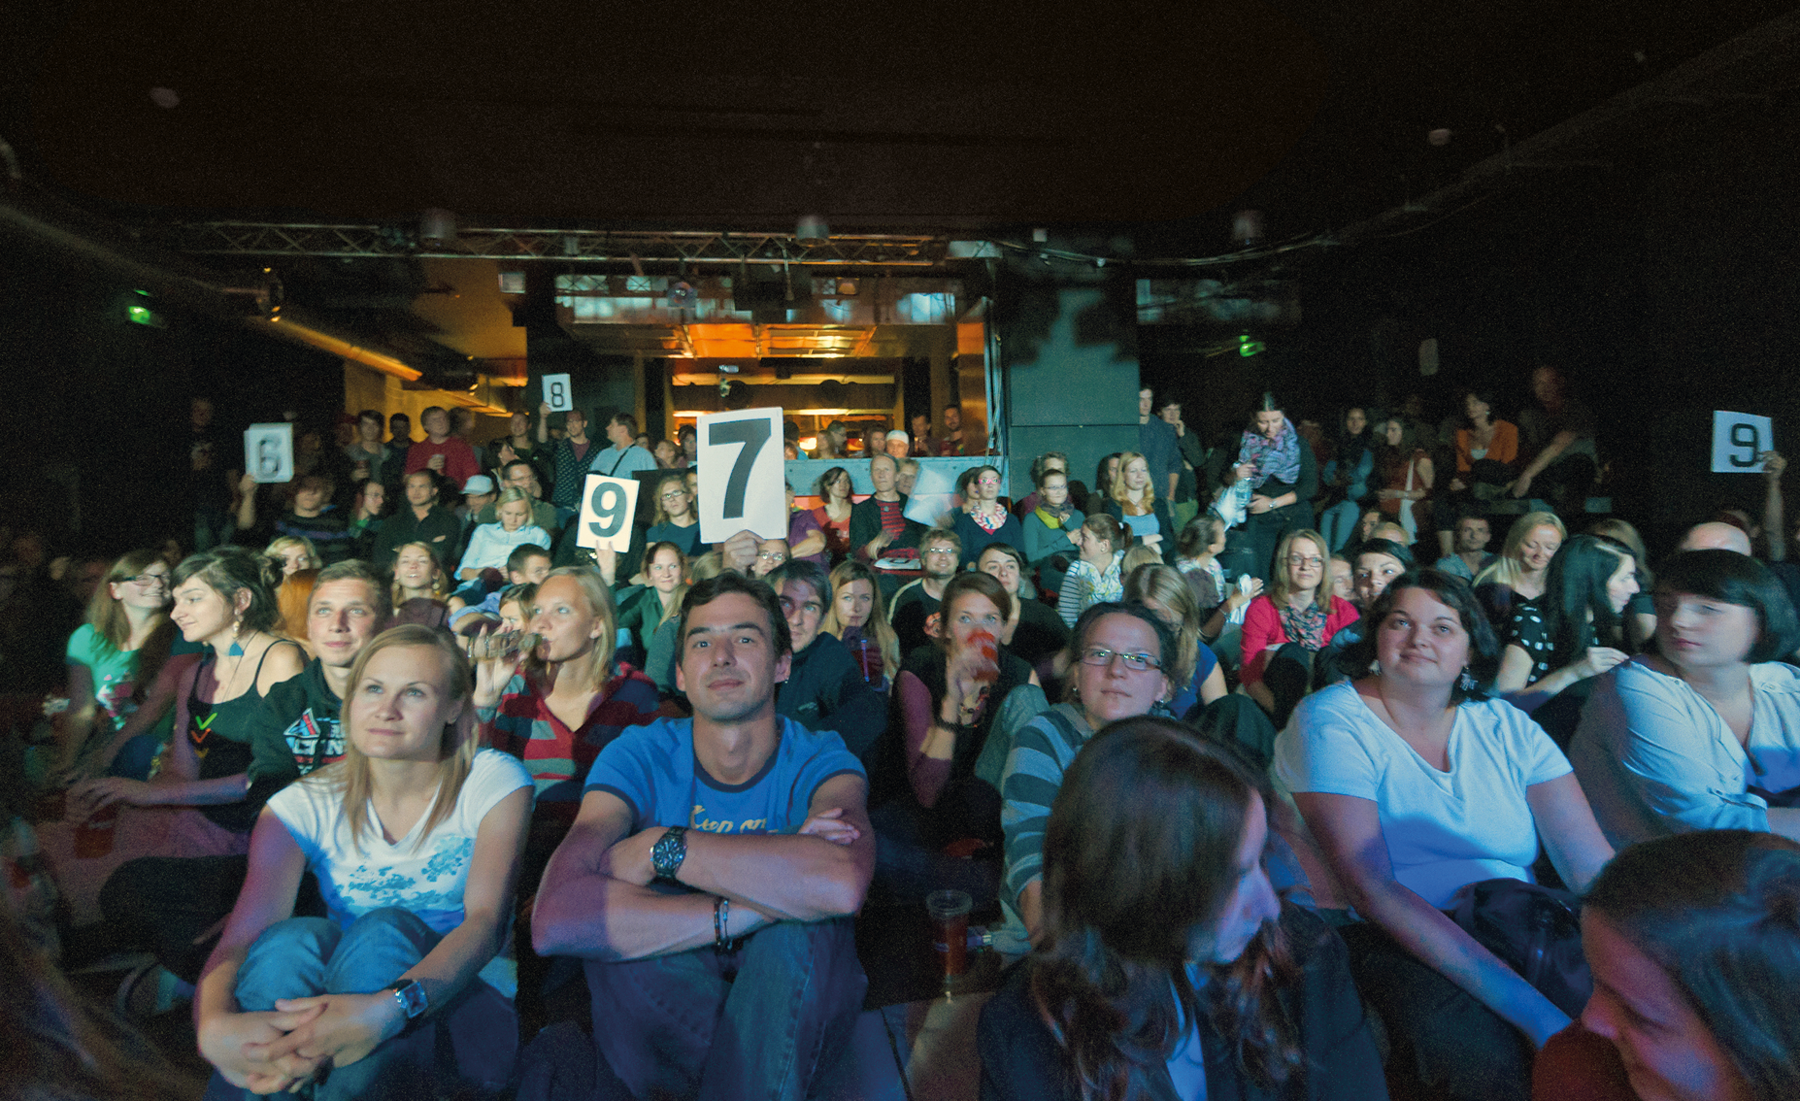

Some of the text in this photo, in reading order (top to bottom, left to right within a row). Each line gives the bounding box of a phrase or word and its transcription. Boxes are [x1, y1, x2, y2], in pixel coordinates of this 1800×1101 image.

[551, 382, 564, 407] 8
[709, 418, 771, 519] 7
[1729, 423, 1759, 467] 9
[588, 482, 627, 538] 9
